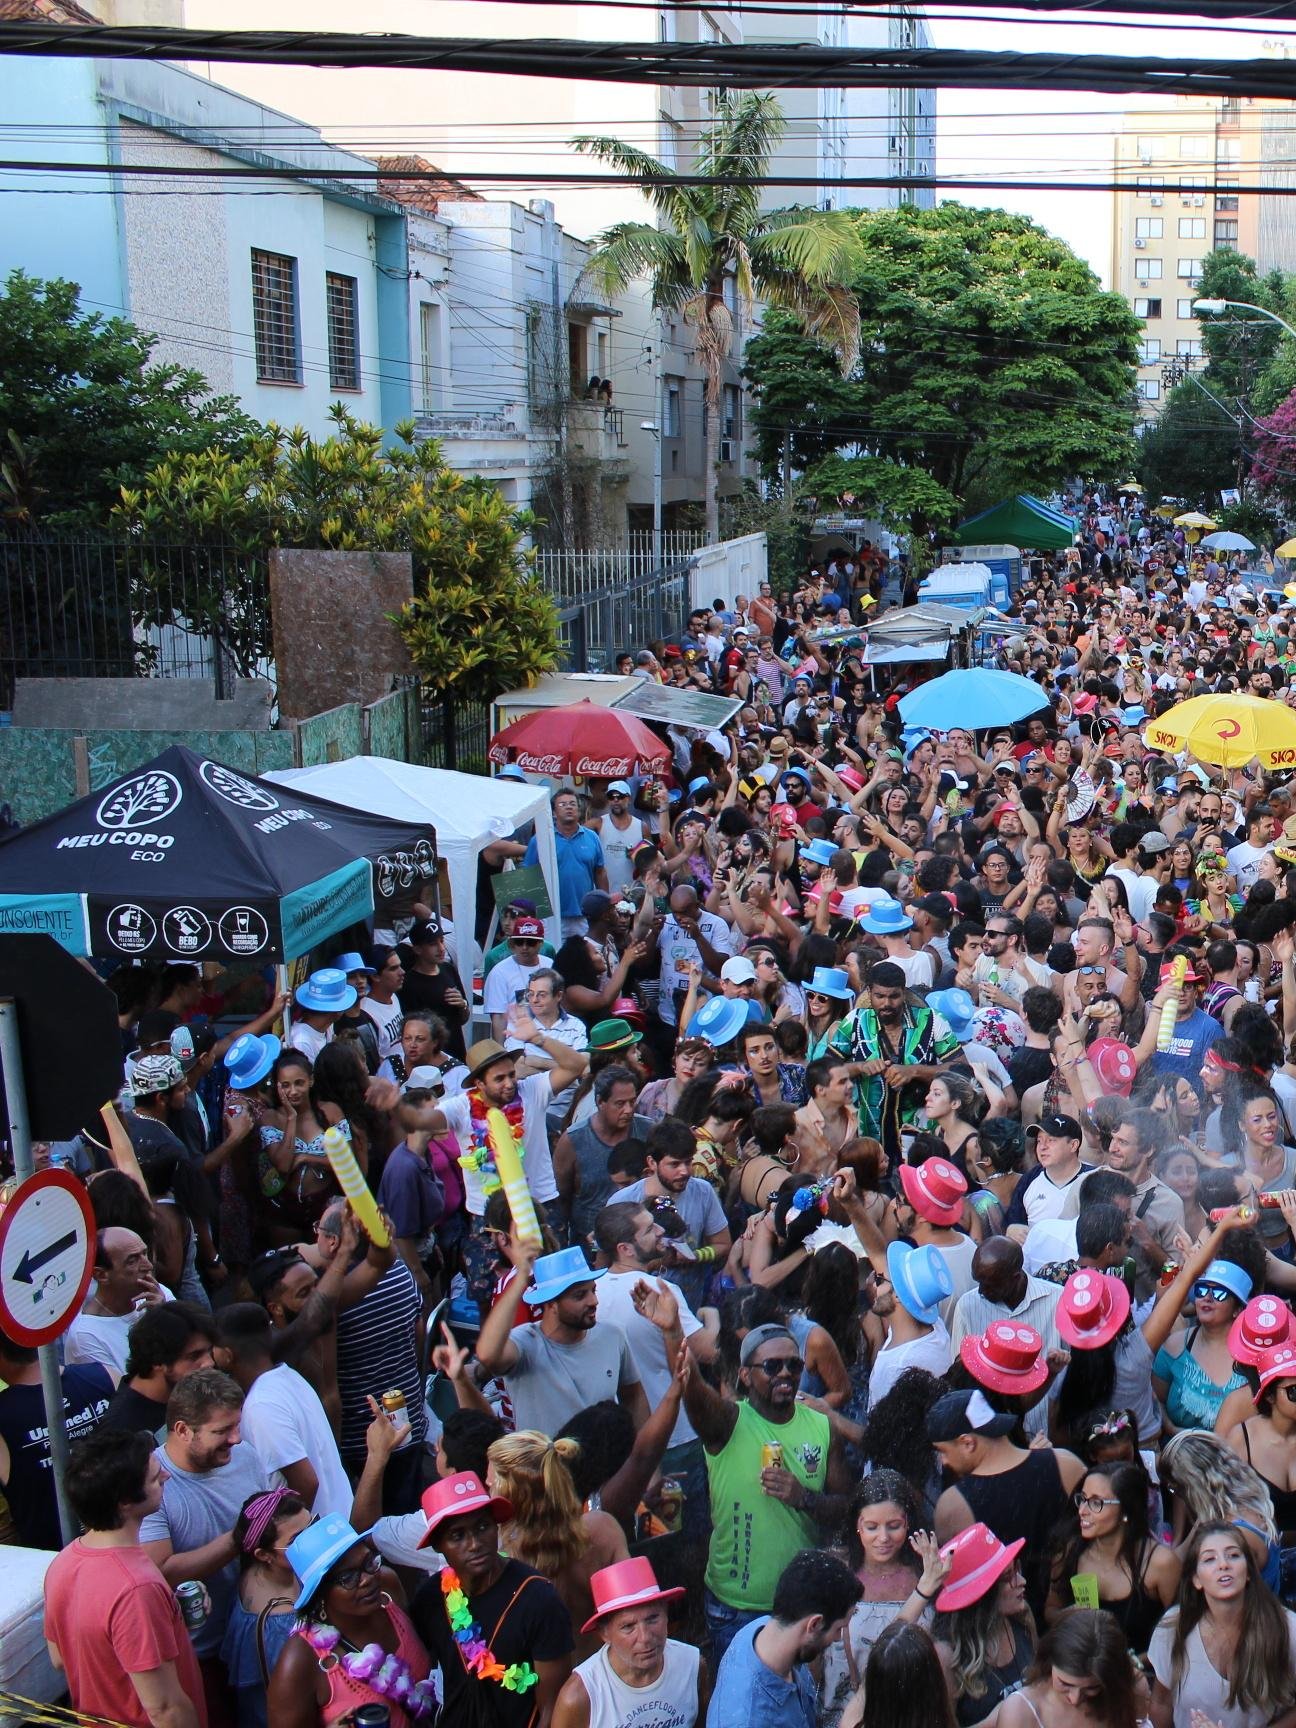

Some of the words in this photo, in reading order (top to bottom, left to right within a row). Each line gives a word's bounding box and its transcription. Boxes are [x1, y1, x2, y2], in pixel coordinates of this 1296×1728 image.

[1154, 730, 1177, 749] SKOL
[516, 751, 563, 774] Coca-Cola
[576, 756, 632, 776] Coca-Cola
[254, 813, 289, 834] MEU
[56, 832, 107, 850] MEU
[108, 831, 175, 849] COPO
[130, 850, 166, 863] ECO
[178, 936, 198, 945] BEBO
[1170, 1038, 1194, 1048] WOOD
[29, 1407, 93, 1441] Unmed
[626, 1700, 677, 1722] DANCEFLOOR
